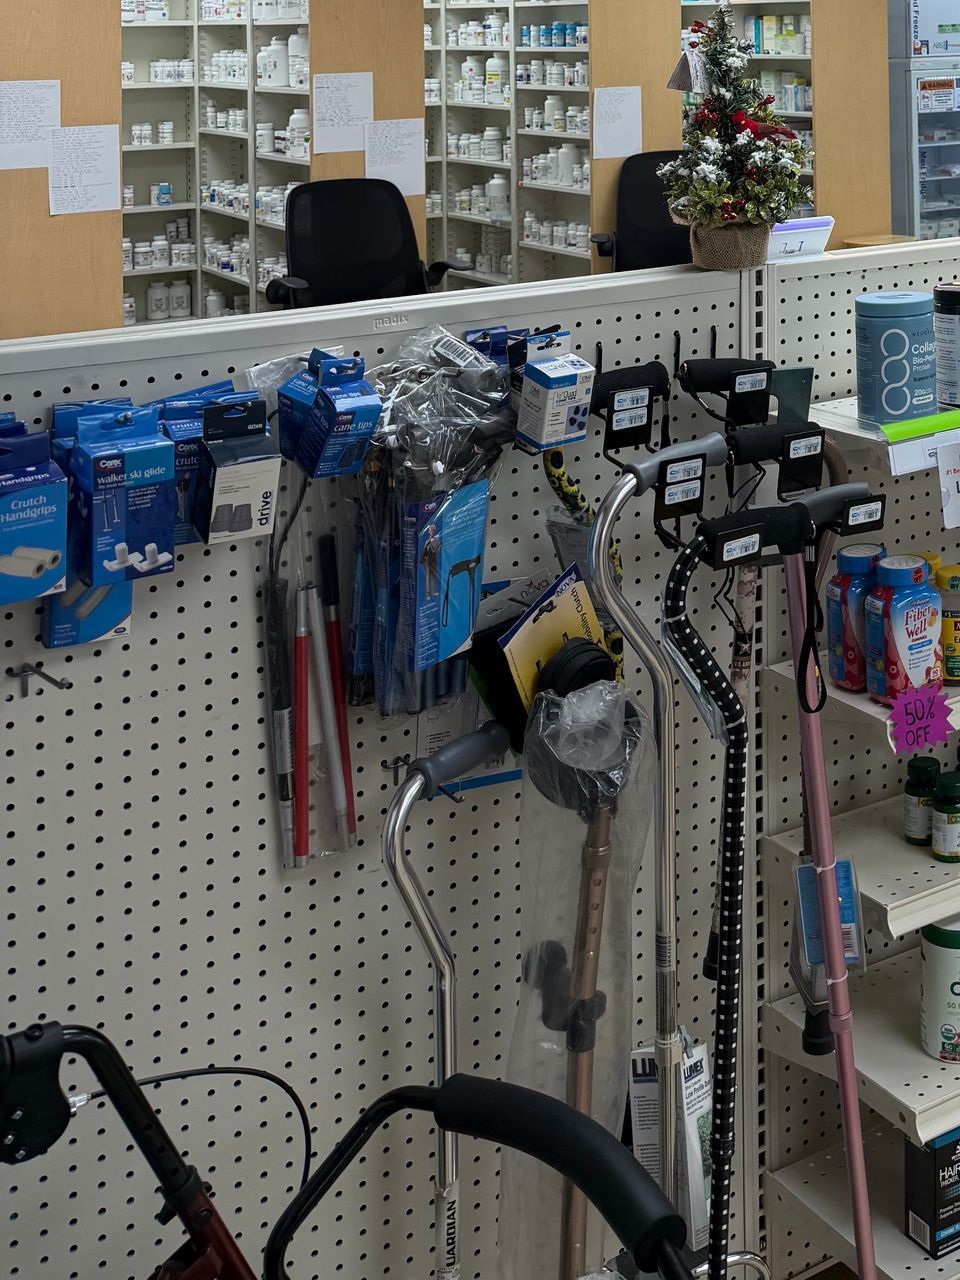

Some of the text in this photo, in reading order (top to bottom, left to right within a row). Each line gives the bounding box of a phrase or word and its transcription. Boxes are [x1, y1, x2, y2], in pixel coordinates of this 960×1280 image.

[912, 364, 931, 372] Protein
[334, 420, 372, 432] cane tips
[178, 443, 198, 451] Carex
[100, 458, 122, 469] Carex
[97, 466, 166, 485] walker ski glide
[11, 495, 47, 510] Crutch
[257, 491, 272, 526] drive
[0, 503, 57, 522] Handgrips
[521, 578, 549, 599] nova
[556, 575, 576, 597] NOVA
[570, 586, 584, 614] Clutch
[904, 605, 932, 627] Fiber
[904, 621, 928, 639] Well
[904, 695, 936, 726] 50%
[905, 725, 932, 747] OFF
[683, 1057, 704, 1080] LUMEX
[685, 1085, 704, 1100] Low Profile
[940, 1175, 960, 1188] THICKER,
